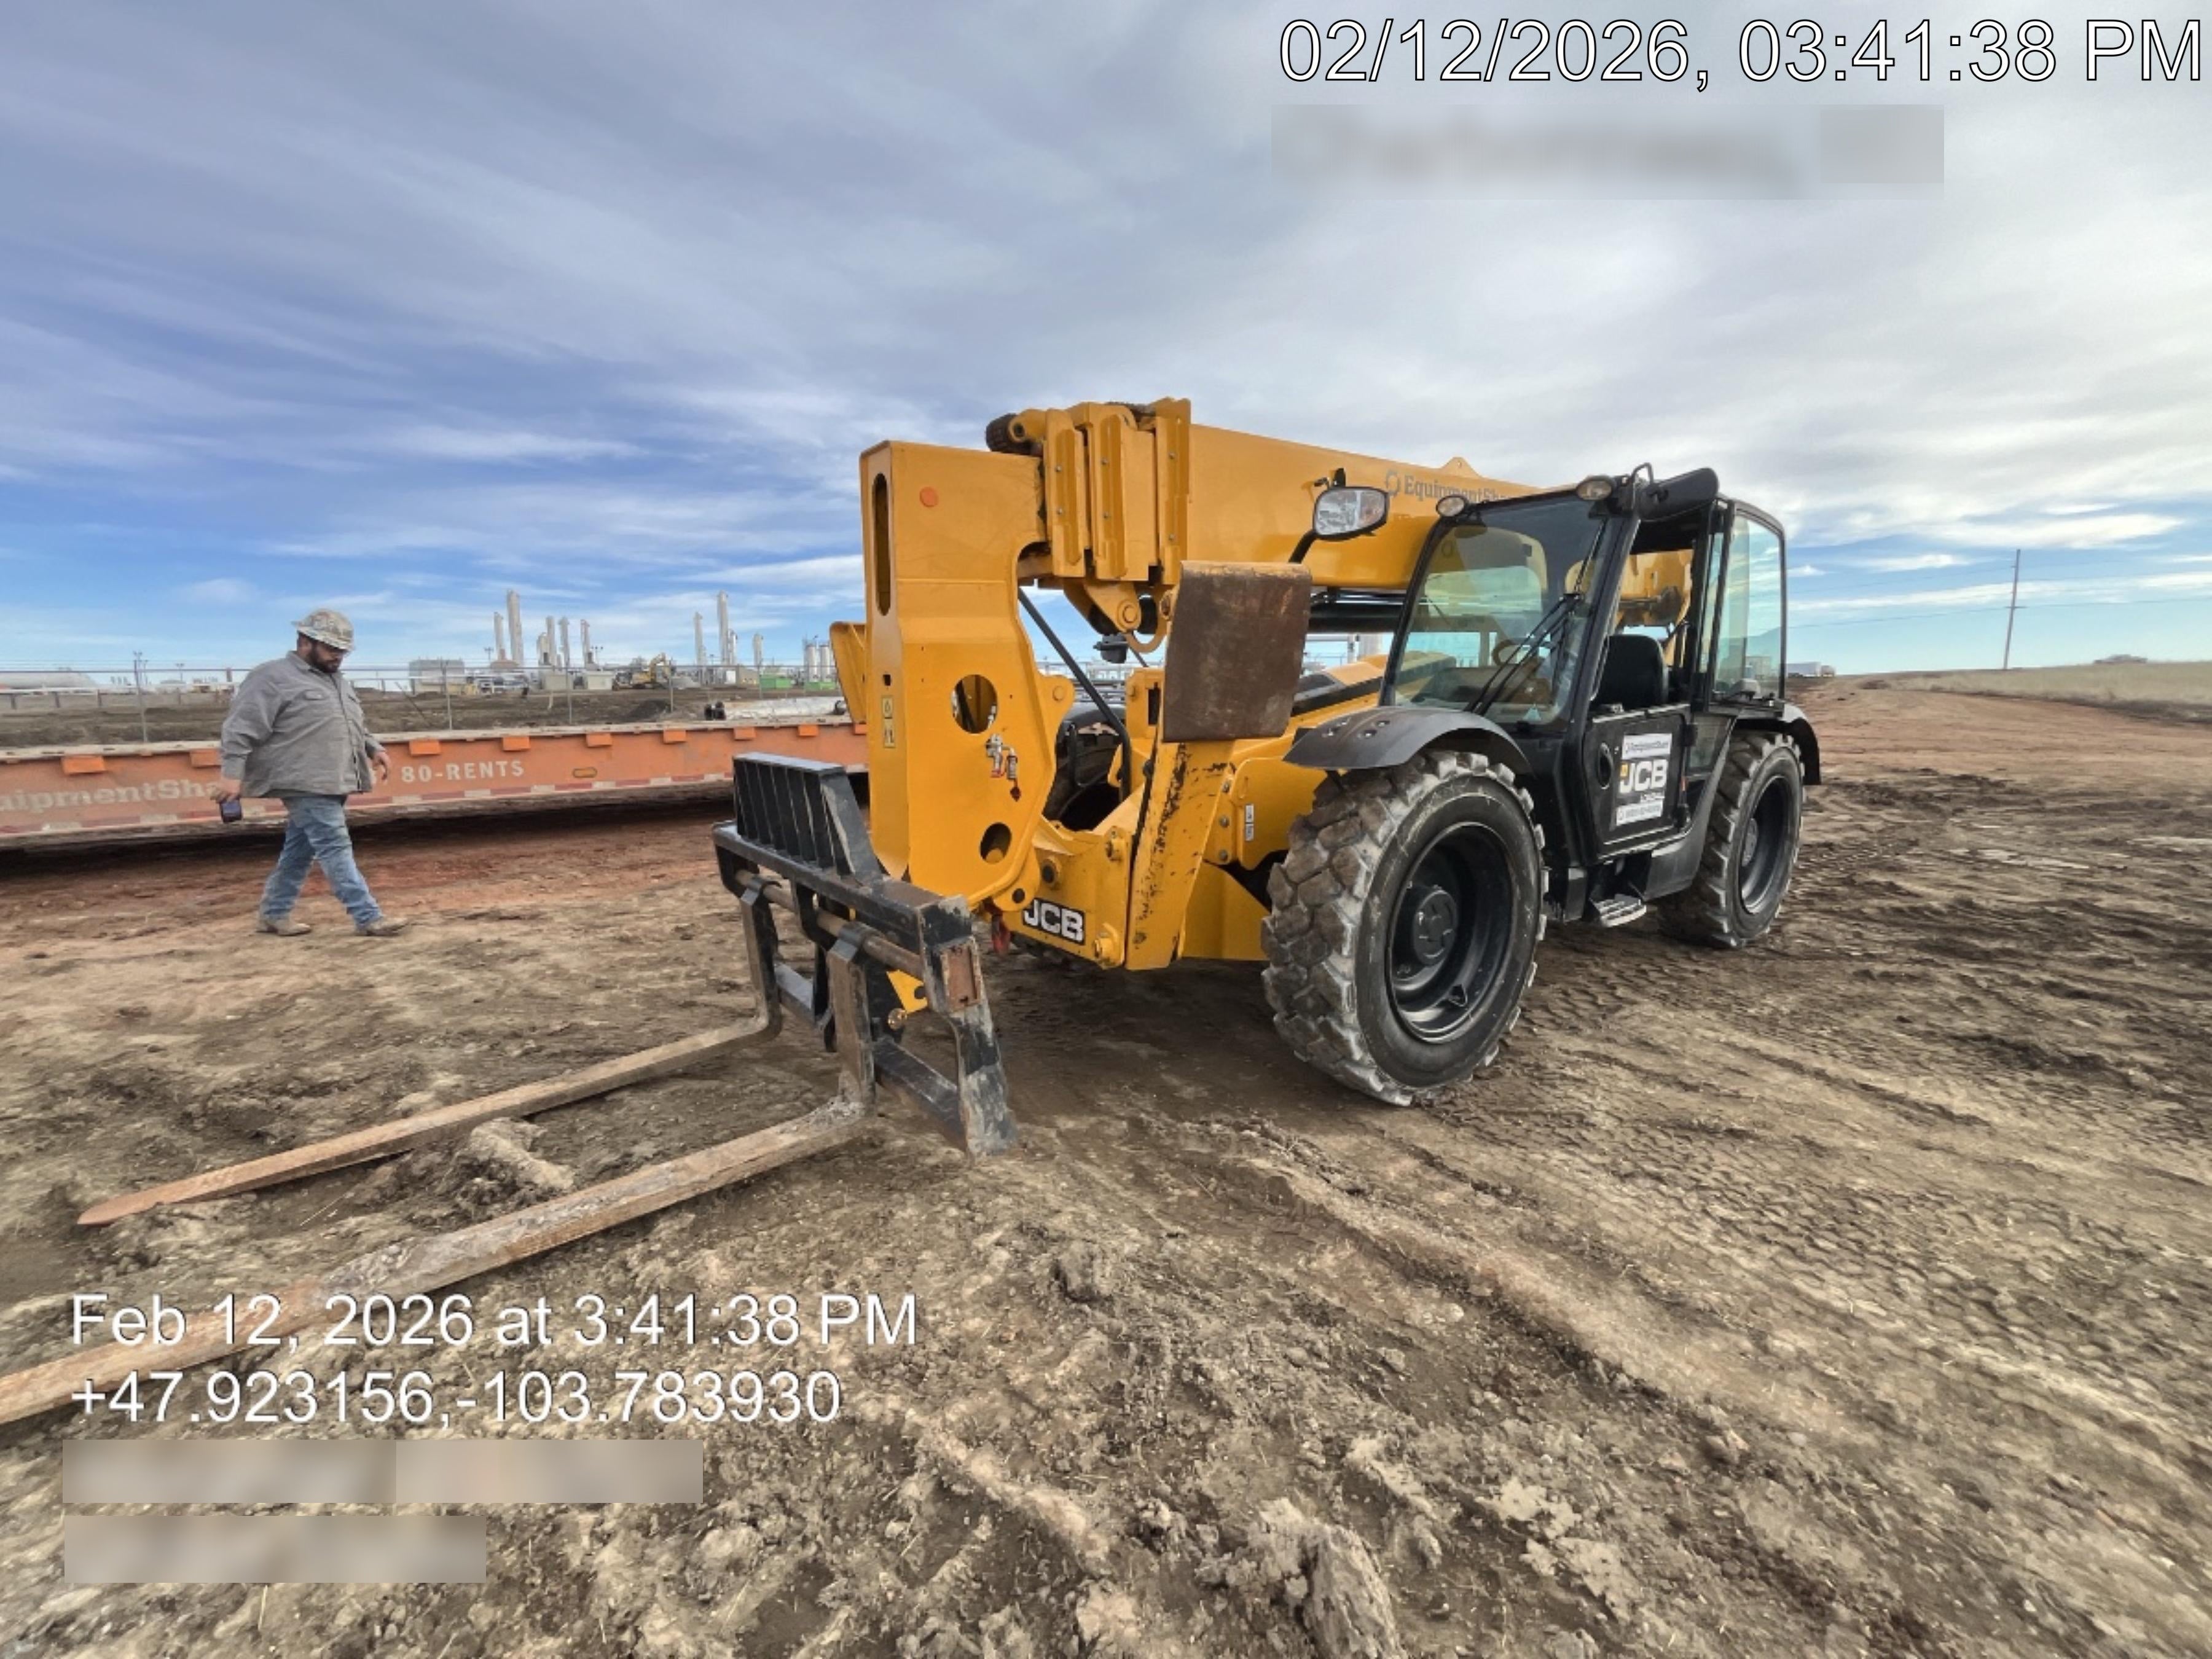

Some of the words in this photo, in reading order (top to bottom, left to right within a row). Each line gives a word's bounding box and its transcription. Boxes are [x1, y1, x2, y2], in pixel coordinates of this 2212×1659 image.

[401, 760, 524, 783] 80-RENTS
[1619, 758, 1668, 793] JCB
[1024, 899, 1083, 942] JCB
